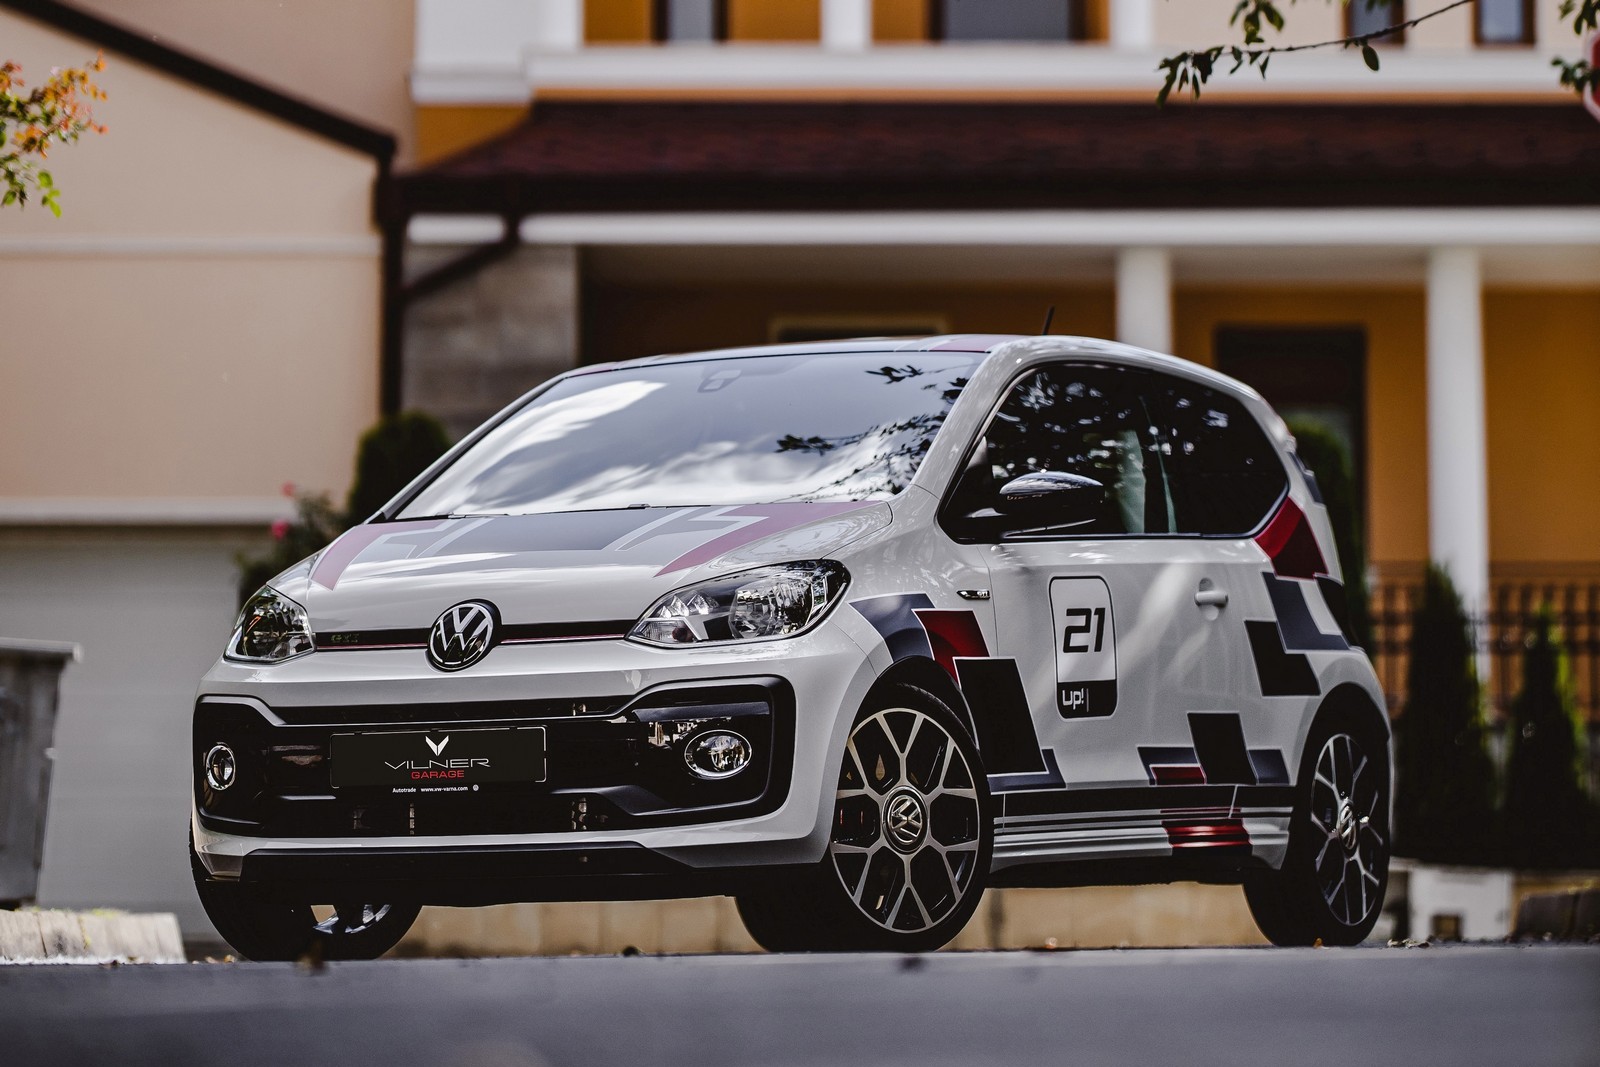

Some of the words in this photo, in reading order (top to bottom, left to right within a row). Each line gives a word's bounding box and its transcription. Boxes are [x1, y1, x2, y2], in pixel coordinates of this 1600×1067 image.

[1063, 607, 1106, 653] 21
[384, 758, 491, 769] VILNER
[411, 770, 464, 779] GARAGE
